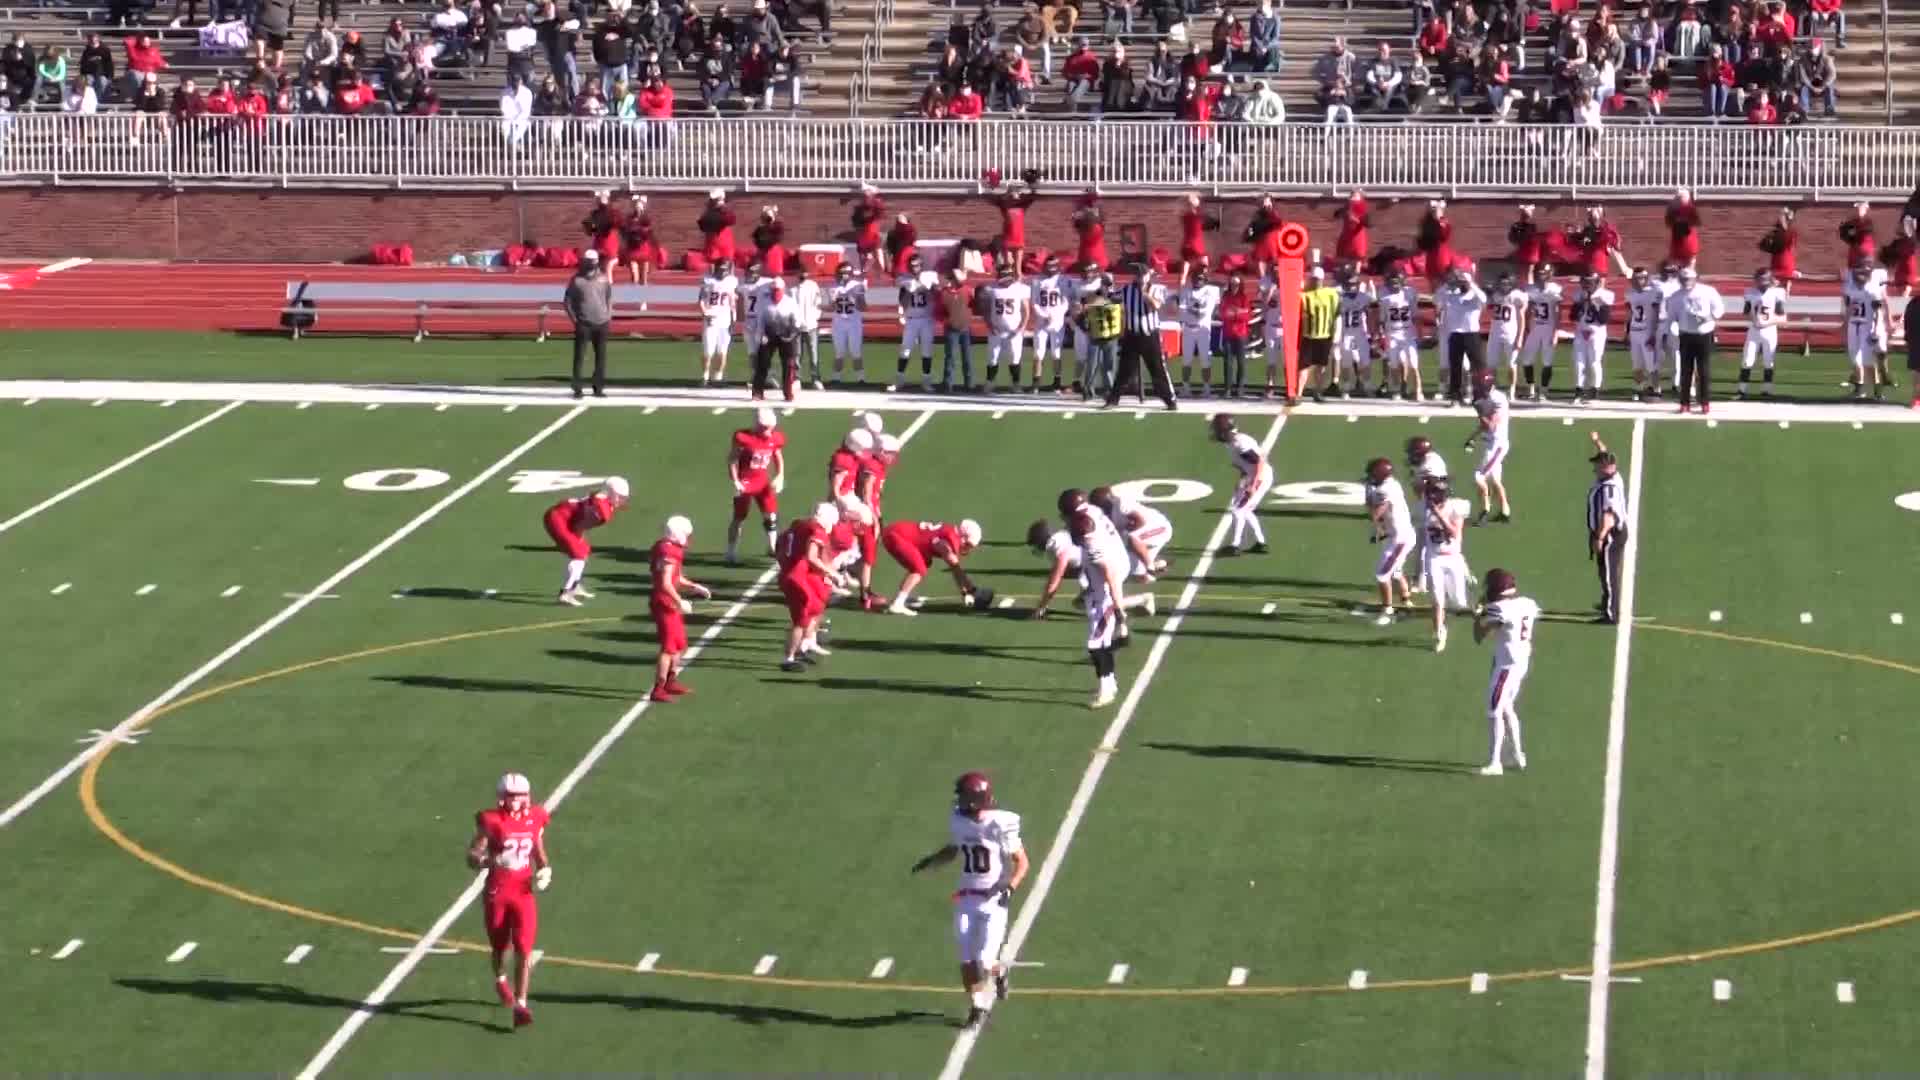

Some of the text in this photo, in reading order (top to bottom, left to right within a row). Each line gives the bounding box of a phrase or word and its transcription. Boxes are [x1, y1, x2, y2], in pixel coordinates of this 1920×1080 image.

[815, 254, 825, 264] G
[748, 295, 758, 312] 7
[501, 838, 533, 869] 22
[962, 844, 990, 873] 10
